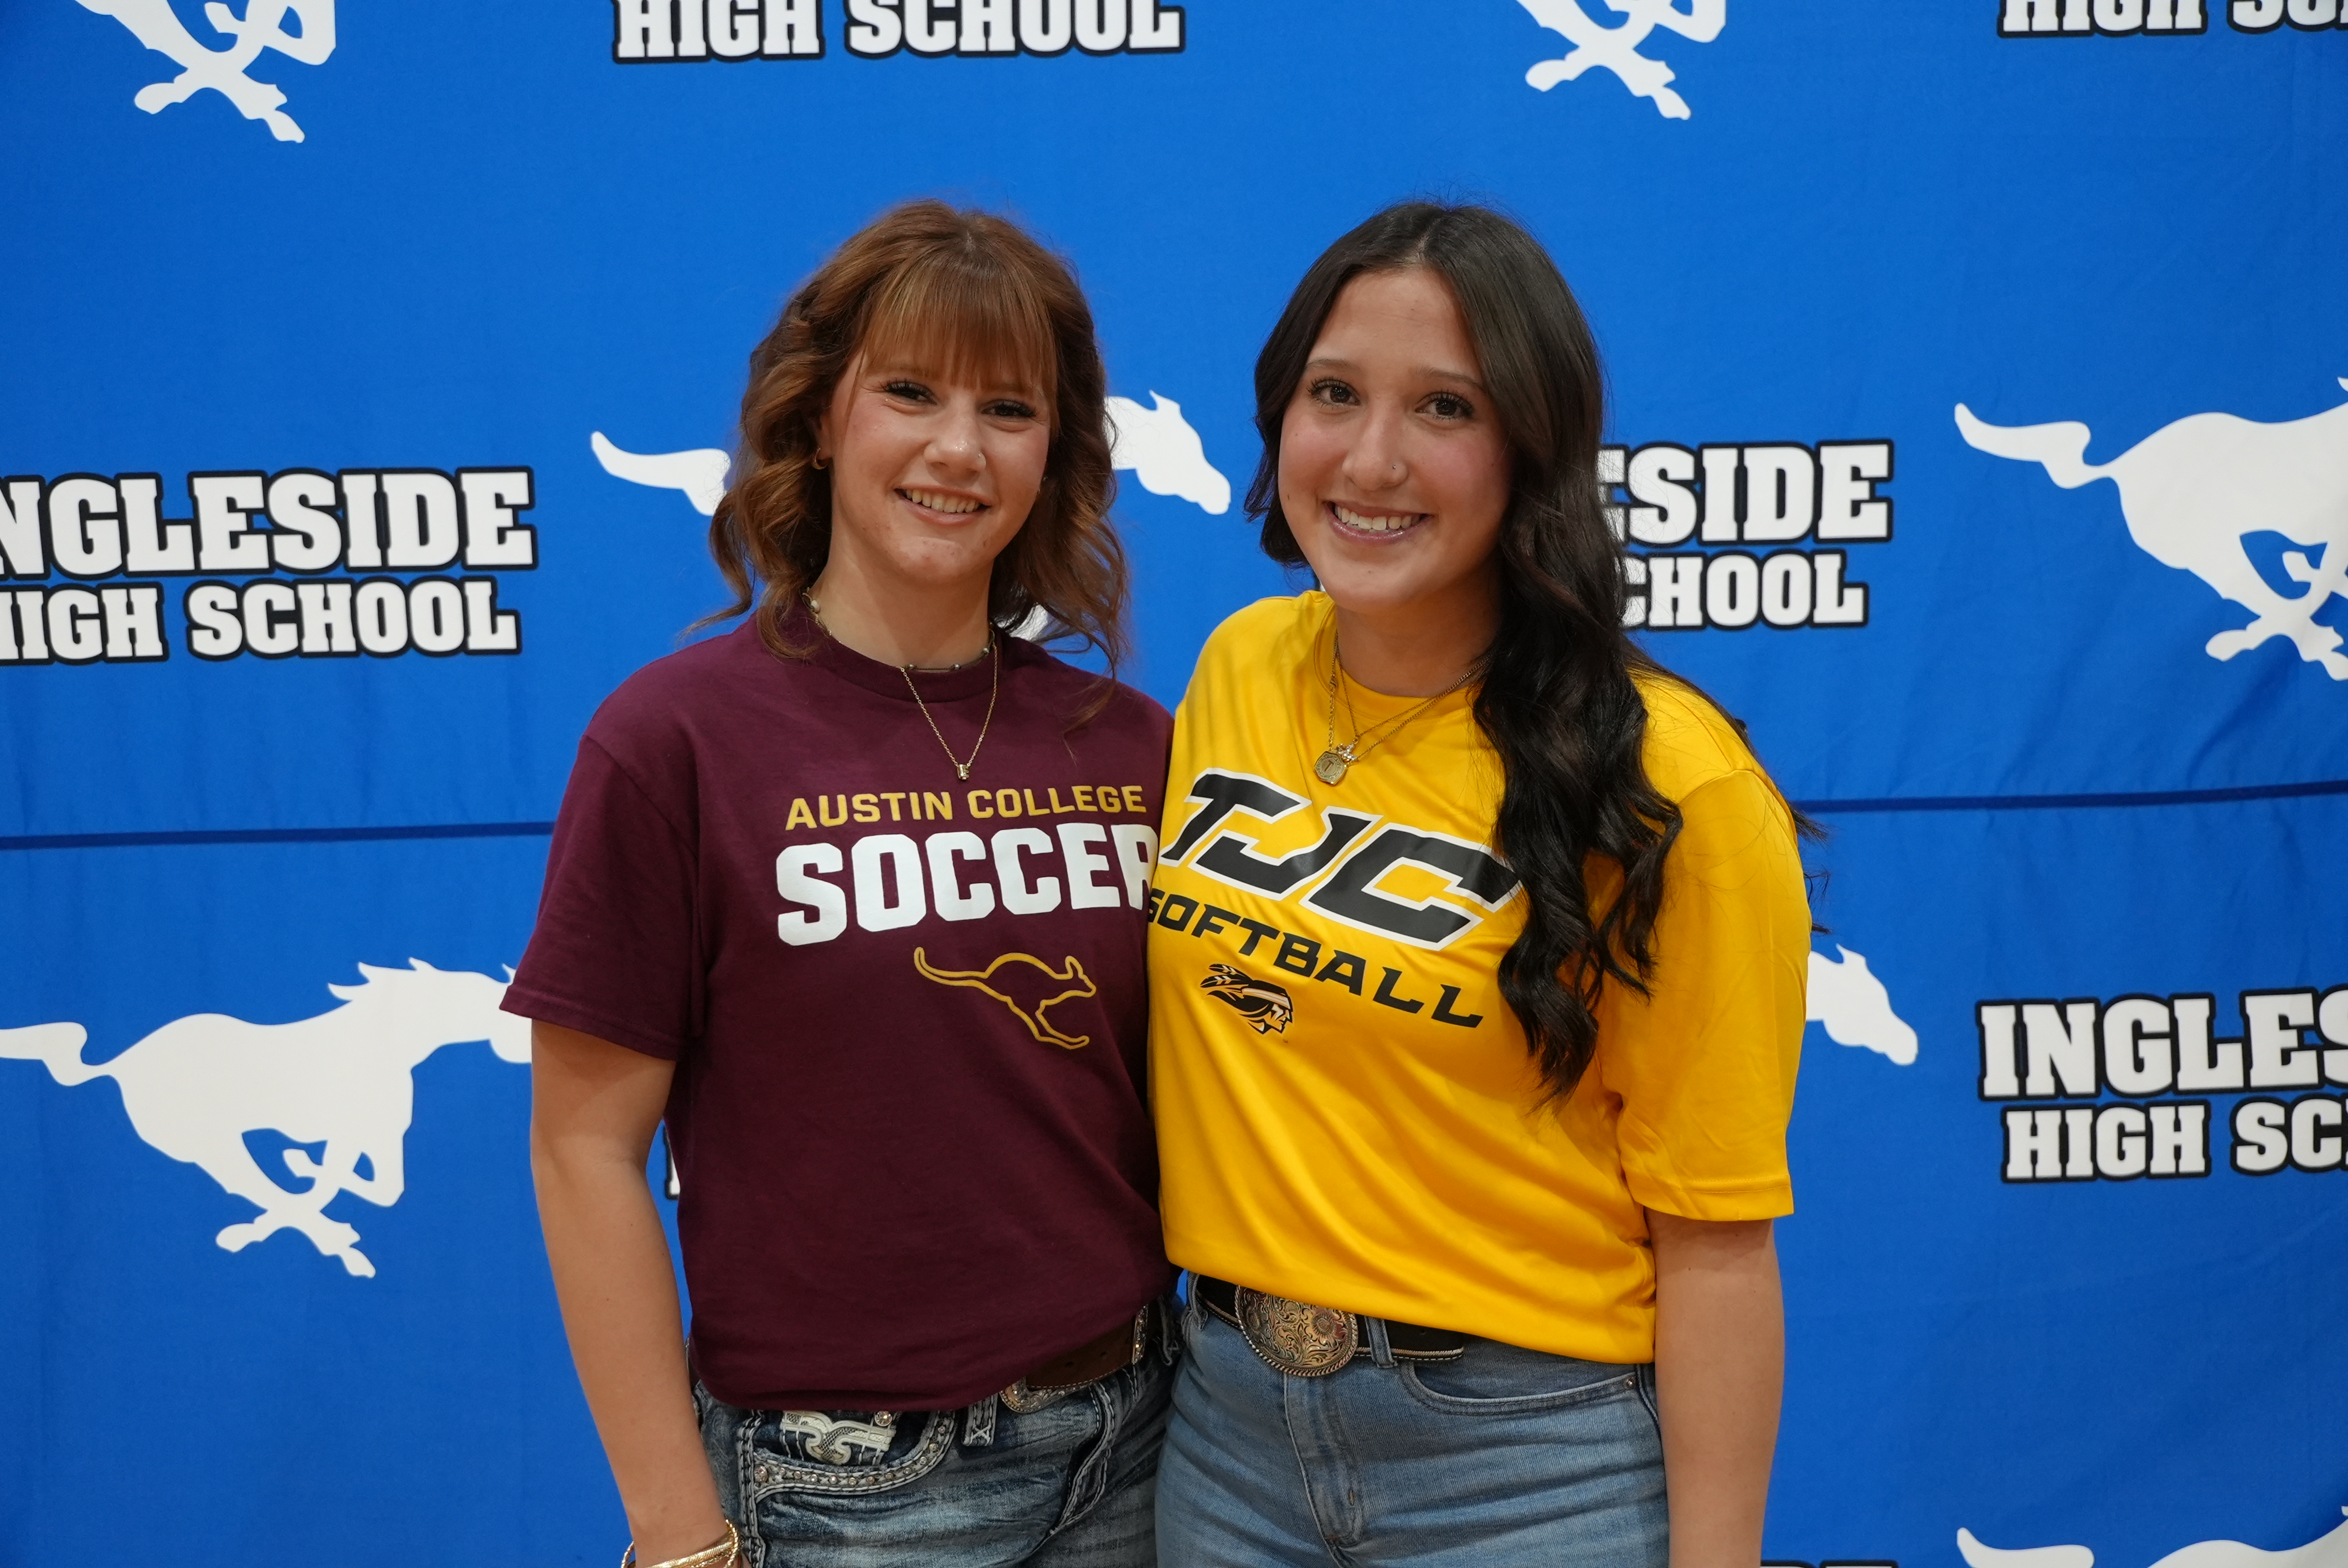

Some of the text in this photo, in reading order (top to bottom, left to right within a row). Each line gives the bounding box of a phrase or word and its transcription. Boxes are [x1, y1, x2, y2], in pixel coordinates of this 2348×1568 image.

[613, 0, 1186, 63] HIGH SCHOOL
[184, 575, 522, 662] SCHOOL
[785, 785, 1147, 830] AUSTIN COLLEGE
[776, 822, 1159, 946] SOCCER
[1158, 767, 1524, 951] TJC
[2001, 1093, 2348, 1183] HIGH SC
